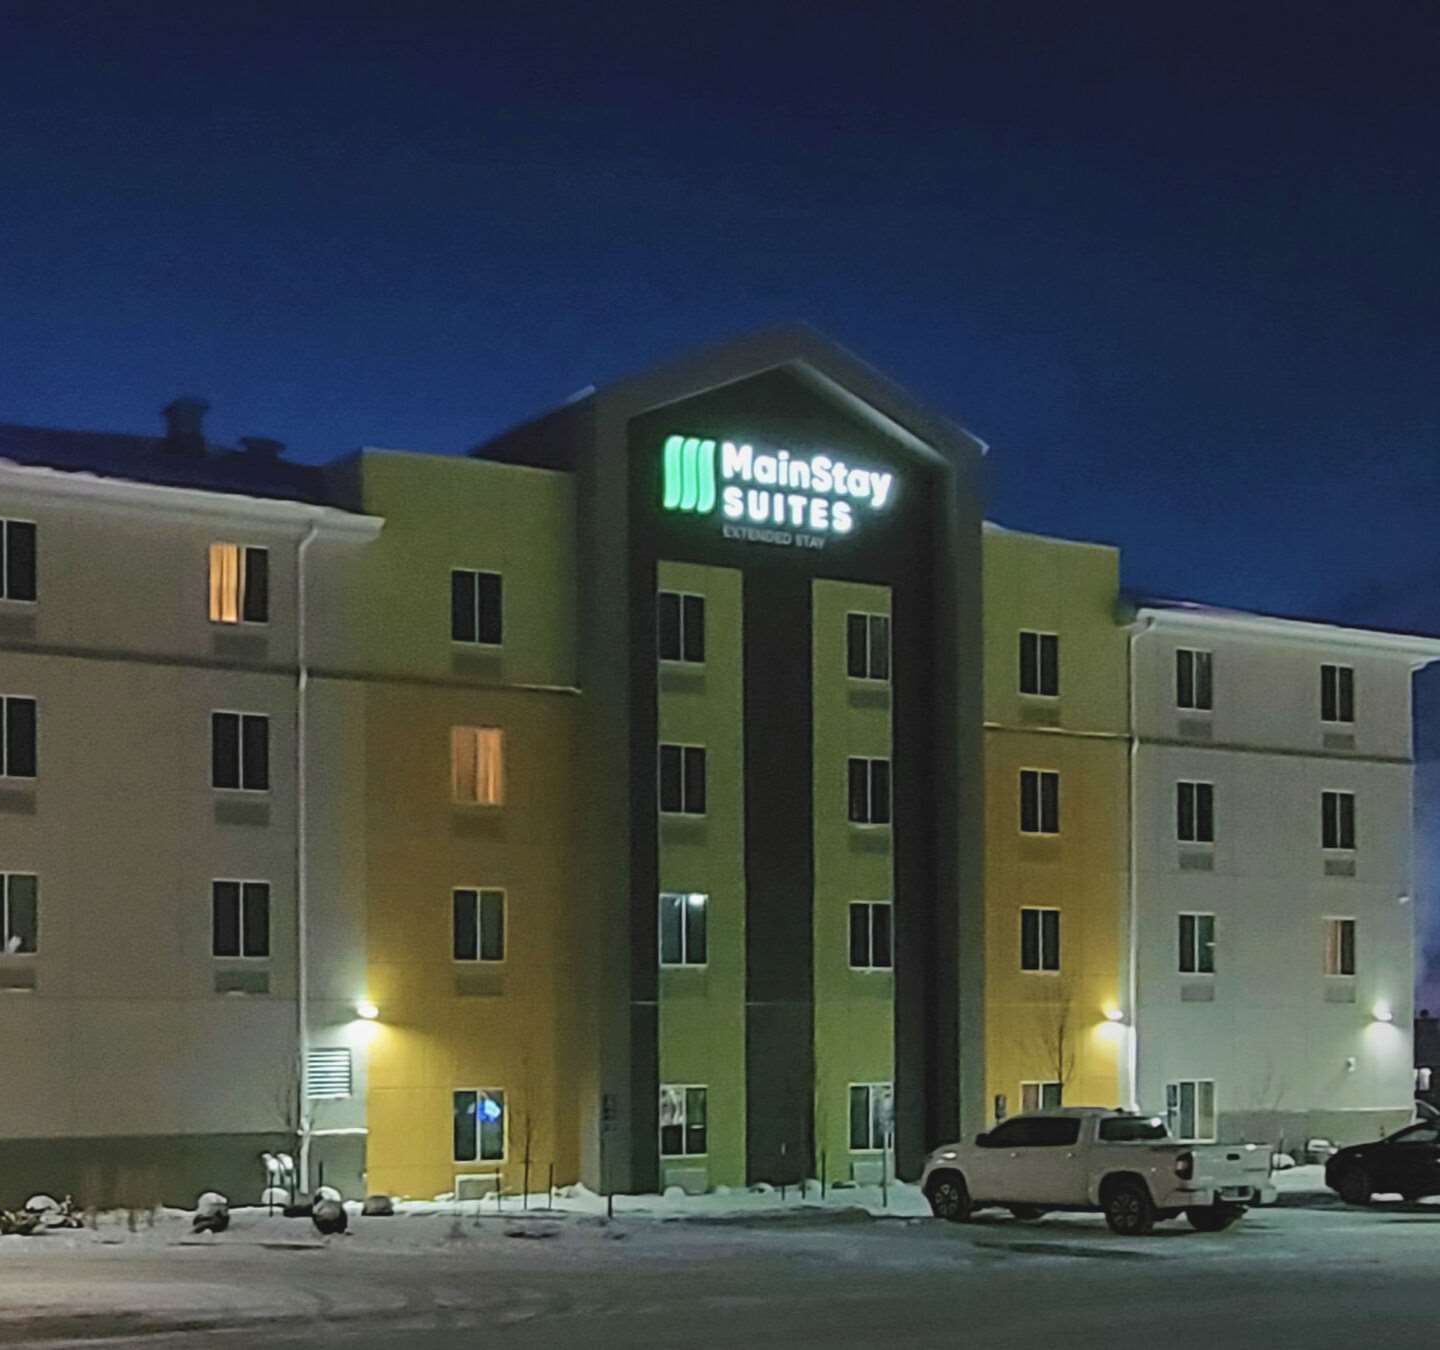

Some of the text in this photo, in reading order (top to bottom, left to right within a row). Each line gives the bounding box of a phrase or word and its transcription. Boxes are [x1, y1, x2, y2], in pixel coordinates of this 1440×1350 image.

[721, 441, 893, 508] MainStay
[723, 487, 853, 534] SUITES
[723, 525, 826, 549] EXTENDED STAY
